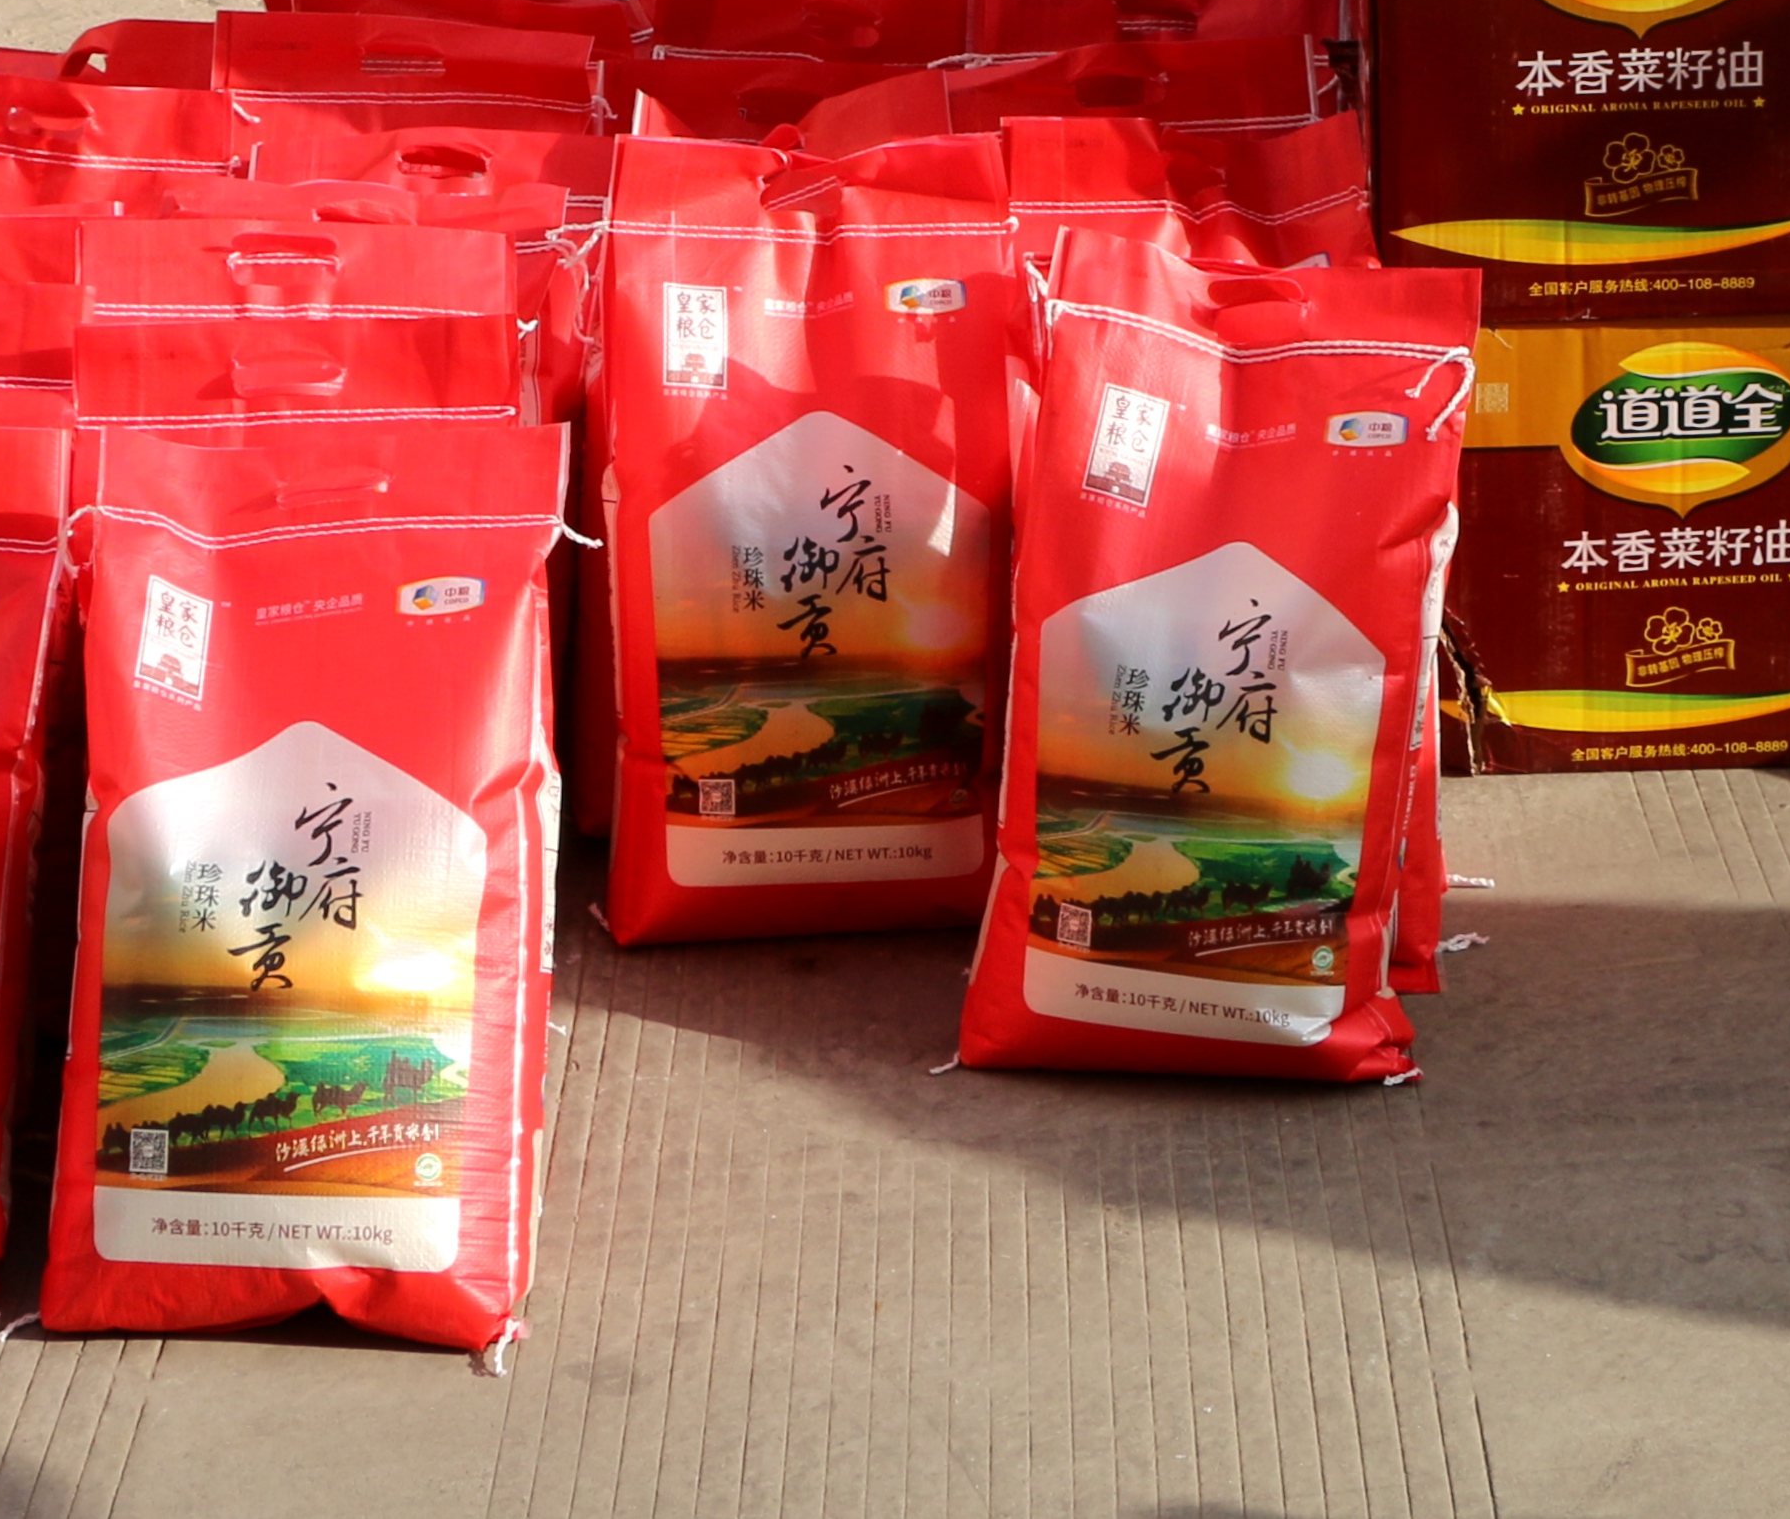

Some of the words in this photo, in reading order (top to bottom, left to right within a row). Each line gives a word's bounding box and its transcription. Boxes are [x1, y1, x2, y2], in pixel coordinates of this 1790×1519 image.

[1516, 41, 1764, 97] 本香菜籽油
[1531, 104, 1596, 115] ORIGINAL
[1600, 102, 1648, 112] AROMA
[1653, 99, 1720, 110] RAPESEED
[1724, 98, 1747, 108] OIL
[675, 291, 716, 314] 皇家
[675, 316, 716, 340] 粮仓
[1115, 395, 1153, 427] 皇家
[1599, 383, 1783, 440] 道道全
[1106, 421, 1149, 453] 粮仓
[743, 546, 764, 611] 珍珠米
[1575, 580, 1638, 591] ORIGINAL
[1642, 578, 1688, 589] AROMA
[1692, 575, 1756, 586] RAPESEED
[1760, 573, 1782, 584] OIL
[158, 591, 198, 625] 皇家
[156, 614, 198, 649] 粮仓
[1119, 667, 1150, 735] 珍珠米
[835, 849, 862, 861] NET
[192, 862, 223, 932] 珍珠米
[1189, 999, 1219, 1017] NET
[278, 1223, 311, 1239] NET
